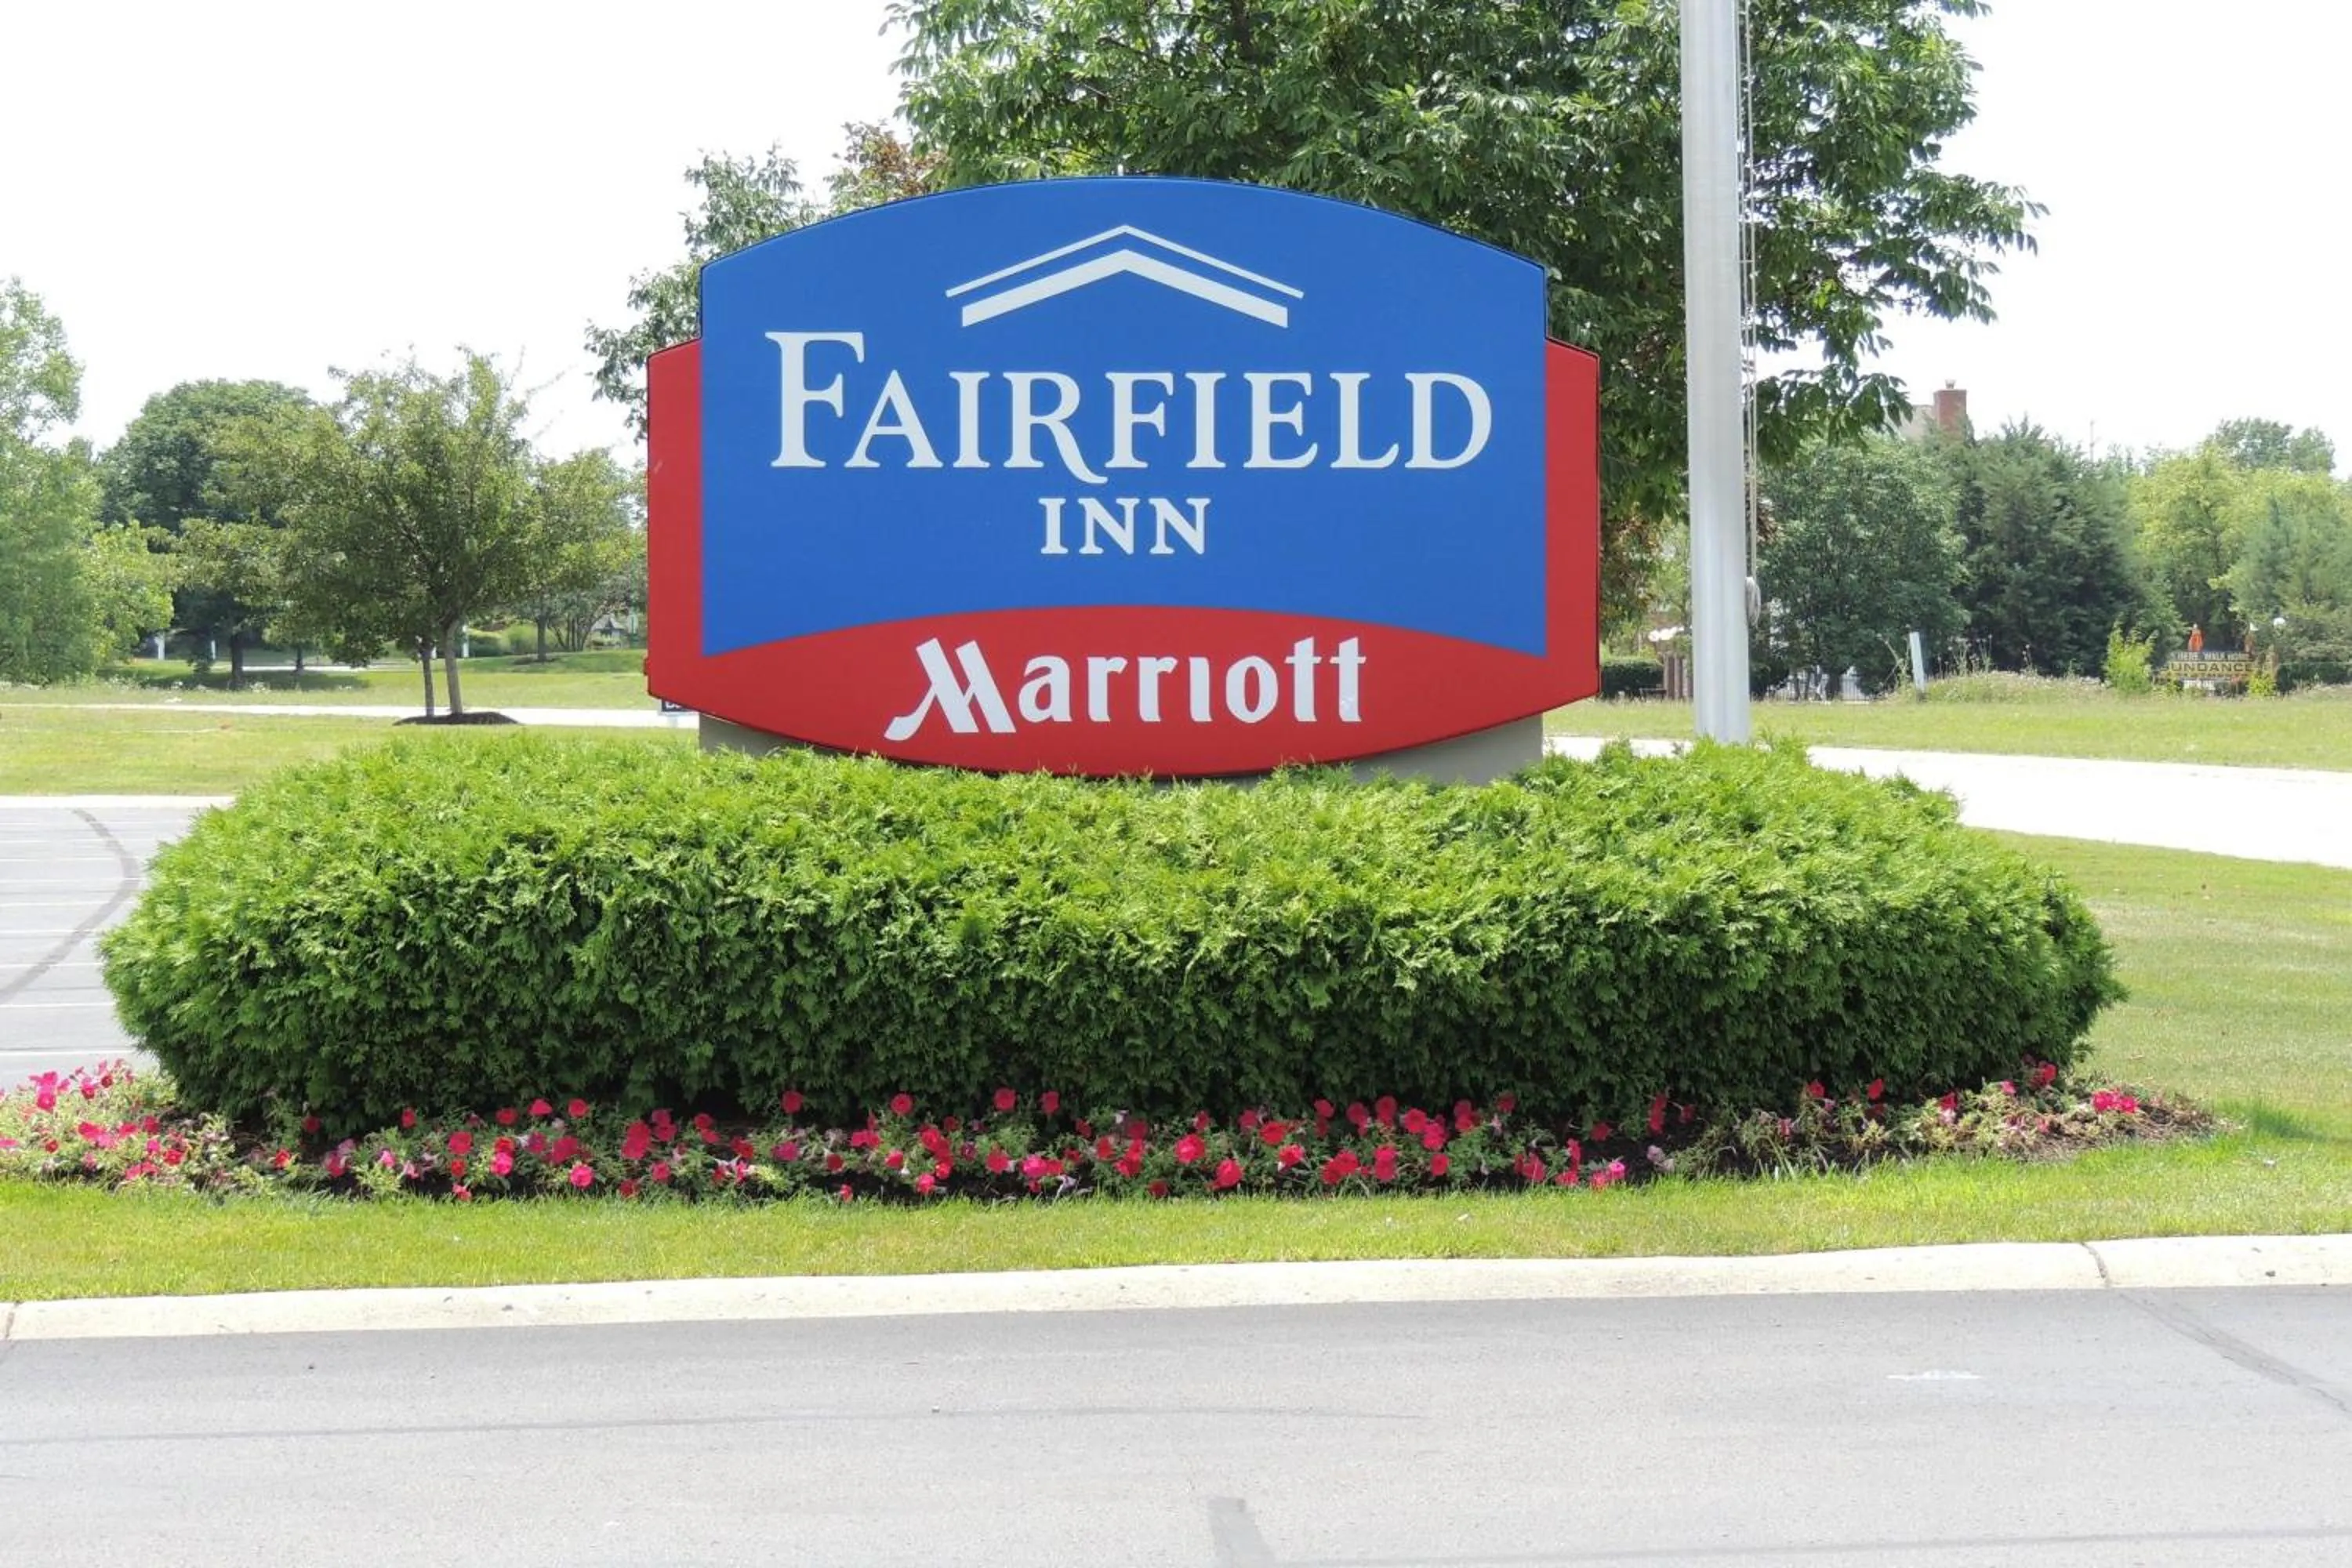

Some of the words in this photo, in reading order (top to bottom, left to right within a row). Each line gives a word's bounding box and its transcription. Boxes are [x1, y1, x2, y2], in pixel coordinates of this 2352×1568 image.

[765, 328, 1493, 484] FAIRFIELD
[1038, 497, 1211, 554] INN
[884, 636, 1367, 742] Marriott
